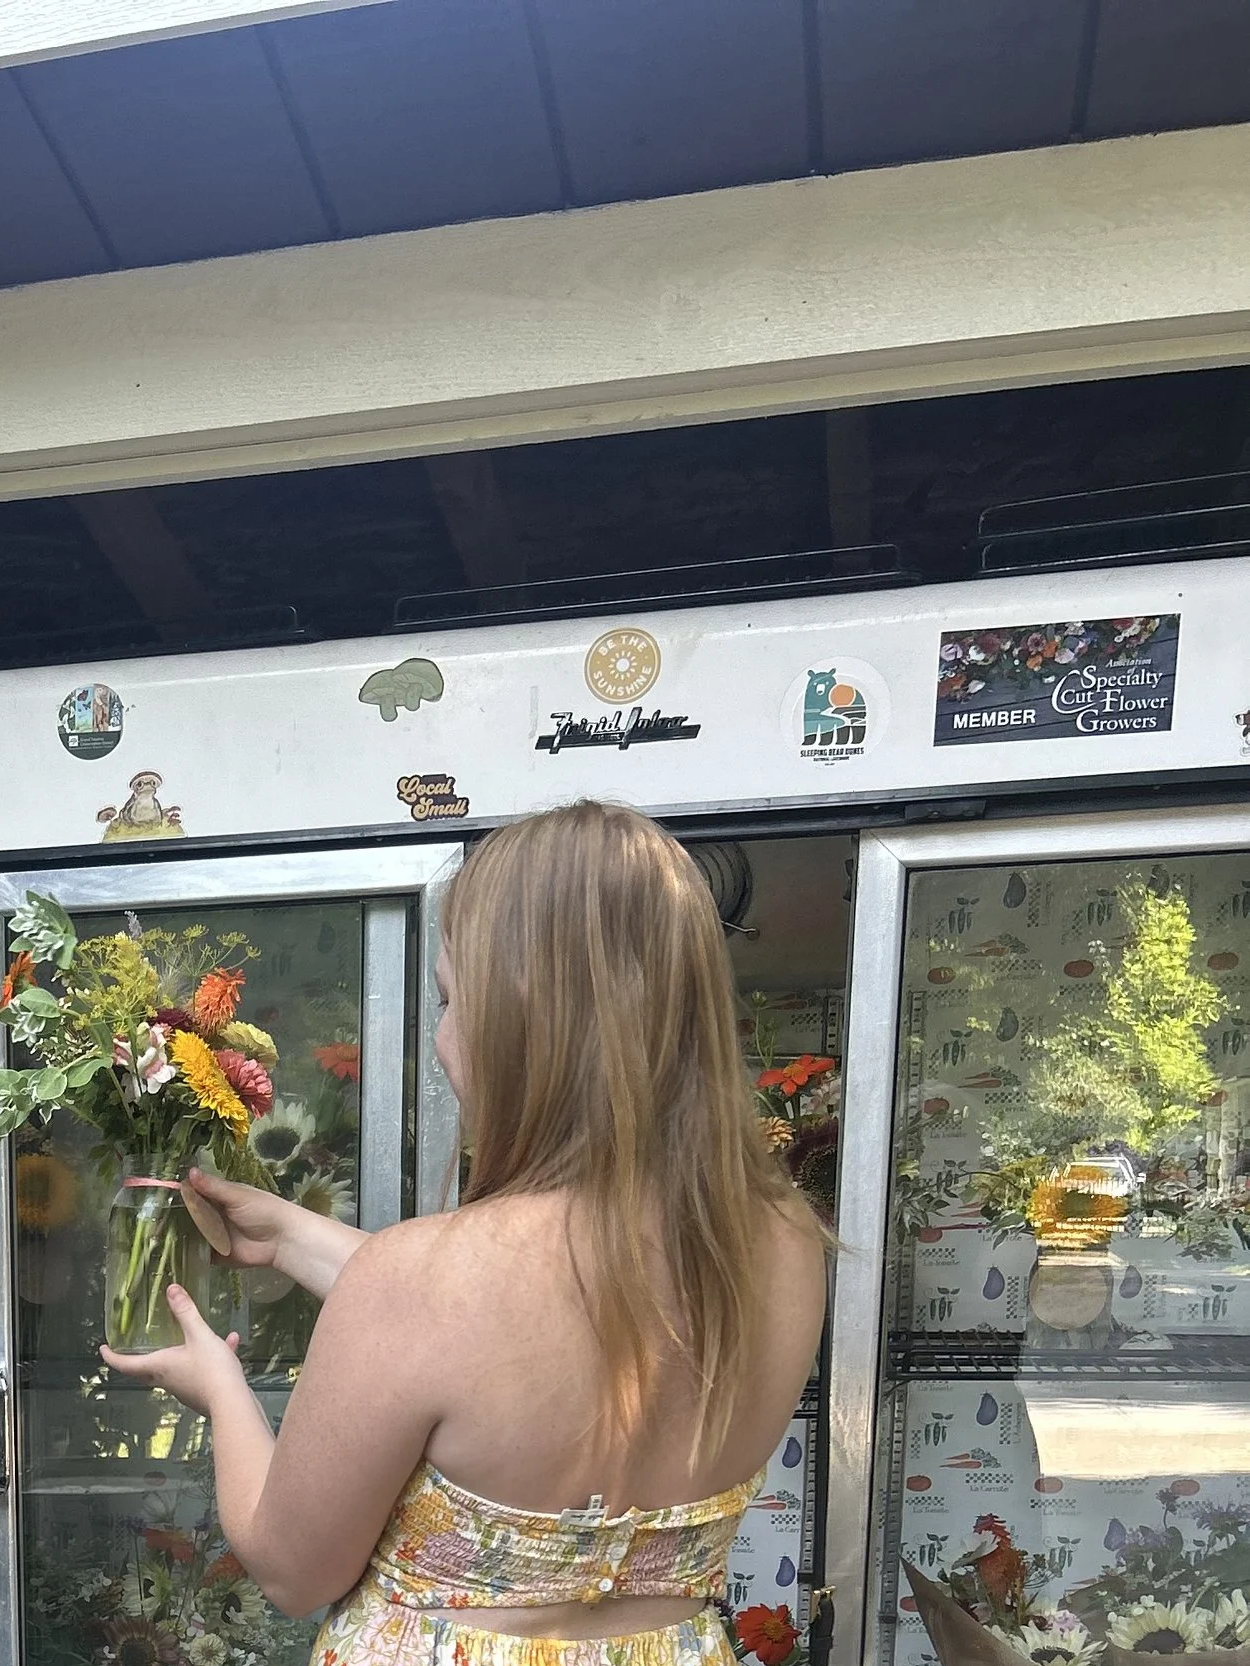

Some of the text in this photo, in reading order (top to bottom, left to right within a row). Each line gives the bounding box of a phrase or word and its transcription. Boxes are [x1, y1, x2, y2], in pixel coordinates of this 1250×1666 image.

[598, 635, 647, 656] BE THE
[593, 665, 652, 697] SUNSHINE
[1080, 665, 1163, 693] Specialty
[1100, 688, 1168, 713] Flower
[953, 708, 1036, 730] MEMBER
[1076, 709, 1157, 733] Growers
[398, 776, 453, 802] Local
[412, 797, 467, 819] Small
